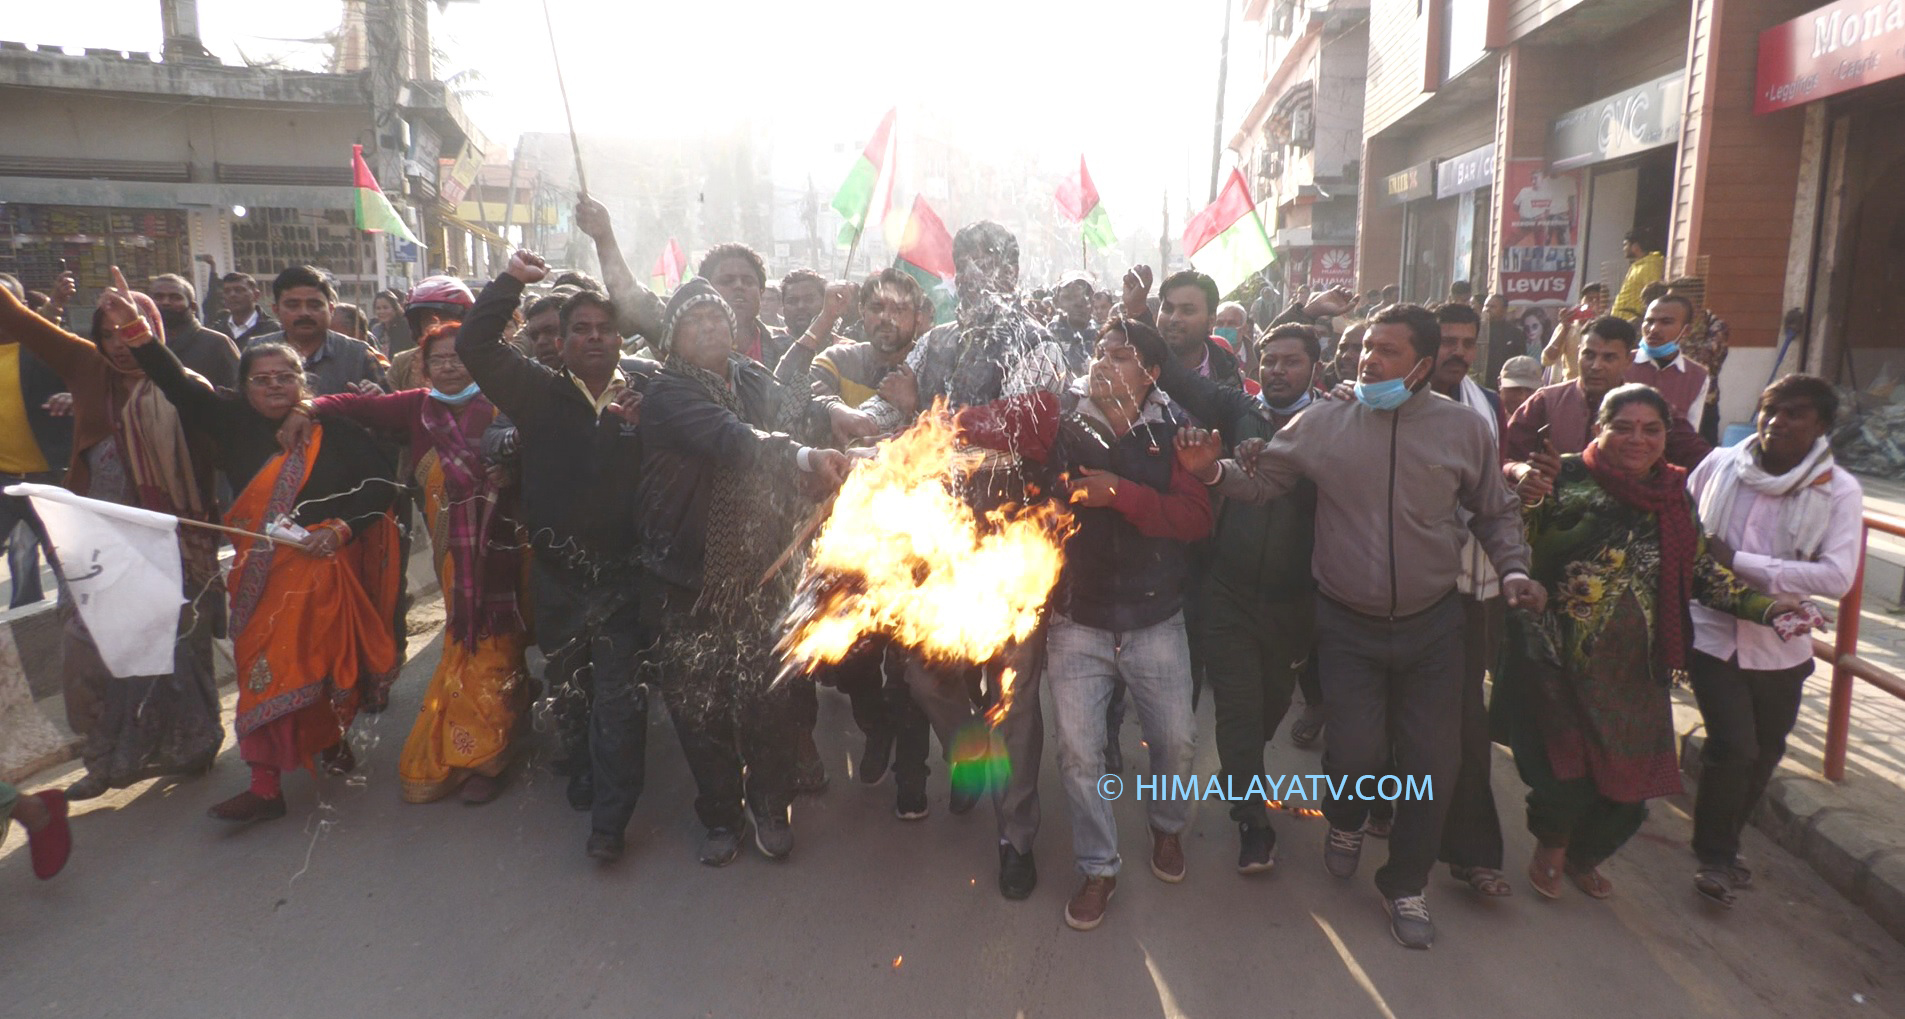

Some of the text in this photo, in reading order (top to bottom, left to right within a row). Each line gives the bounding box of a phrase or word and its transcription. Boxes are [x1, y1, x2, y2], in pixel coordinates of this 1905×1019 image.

[1769, 73, 1818, 101] Leggings
[1838, 51, 1881, 80] Capris
[1598, 91, 1649, 153] CVC
[1457, 162, 1476, 185] BAR
